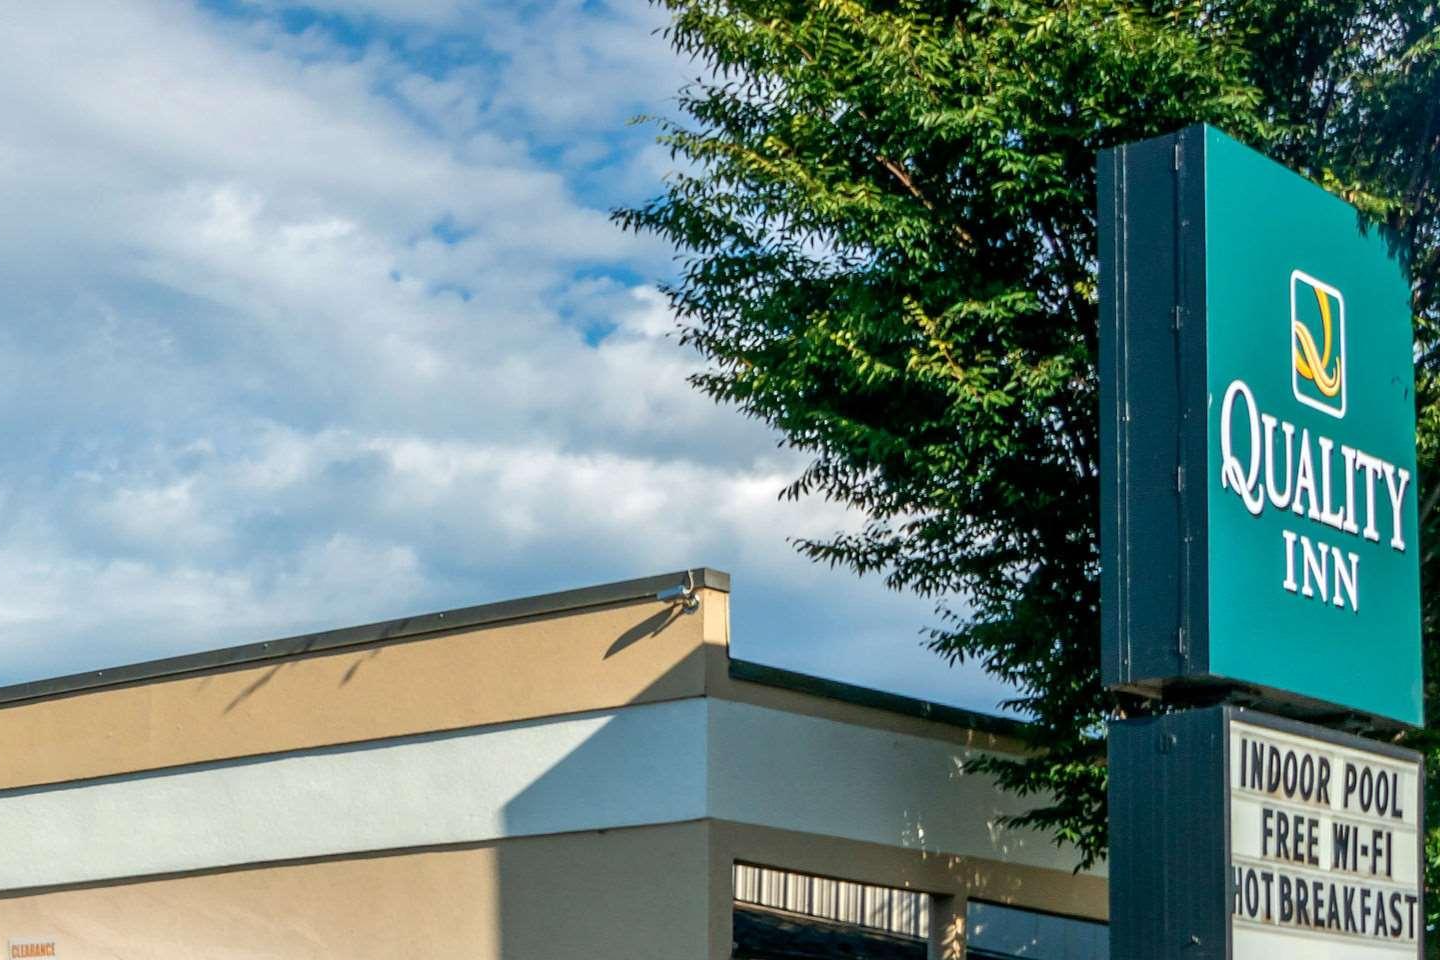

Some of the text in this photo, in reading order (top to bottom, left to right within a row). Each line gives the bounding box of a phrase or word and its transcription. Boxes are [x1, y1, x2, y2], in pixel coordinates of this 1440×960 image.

[1220, 379, 1410, 552] QUALITY
[1283, 530, 1360, 611] INN
[1240, 738, 1403, 818] INDOOR POOL
[1262, 808, 1392, 877] FREE WI-FI
[11, 942, 56, 959] CLEARANCE
